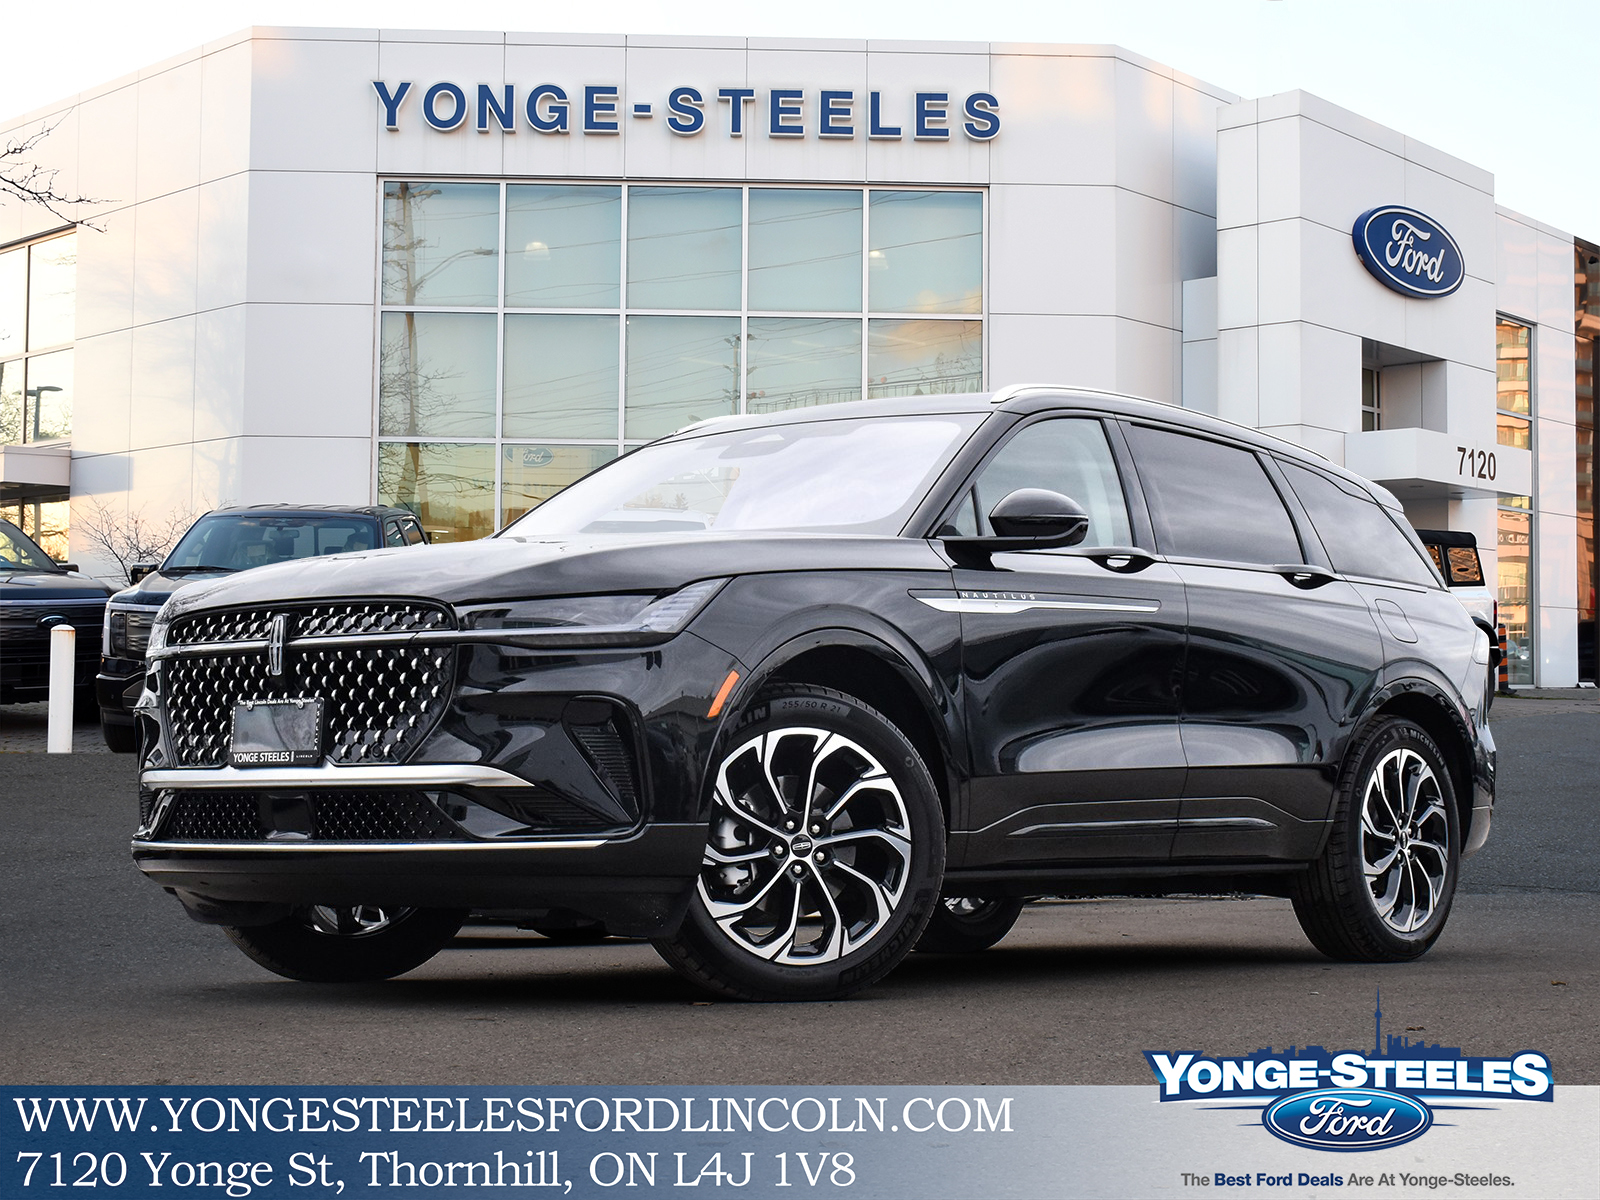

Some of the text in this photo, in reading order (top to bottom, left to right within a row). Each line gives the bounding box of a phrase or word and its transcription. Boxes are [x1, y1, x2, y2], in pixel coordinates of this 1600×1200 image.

[372, 80, 1002, 142] YONGE-STEELES
[1385, 218, 1446, 284] Ford
[1457, 446, 1497, 481] 7120
[961, 591, 1036, 600] NAUTILUS
[782, 700, 818, 710] 255/50
[233, 753, 259, 763] YONGE
[260, 751, 290, 762] STEELES
